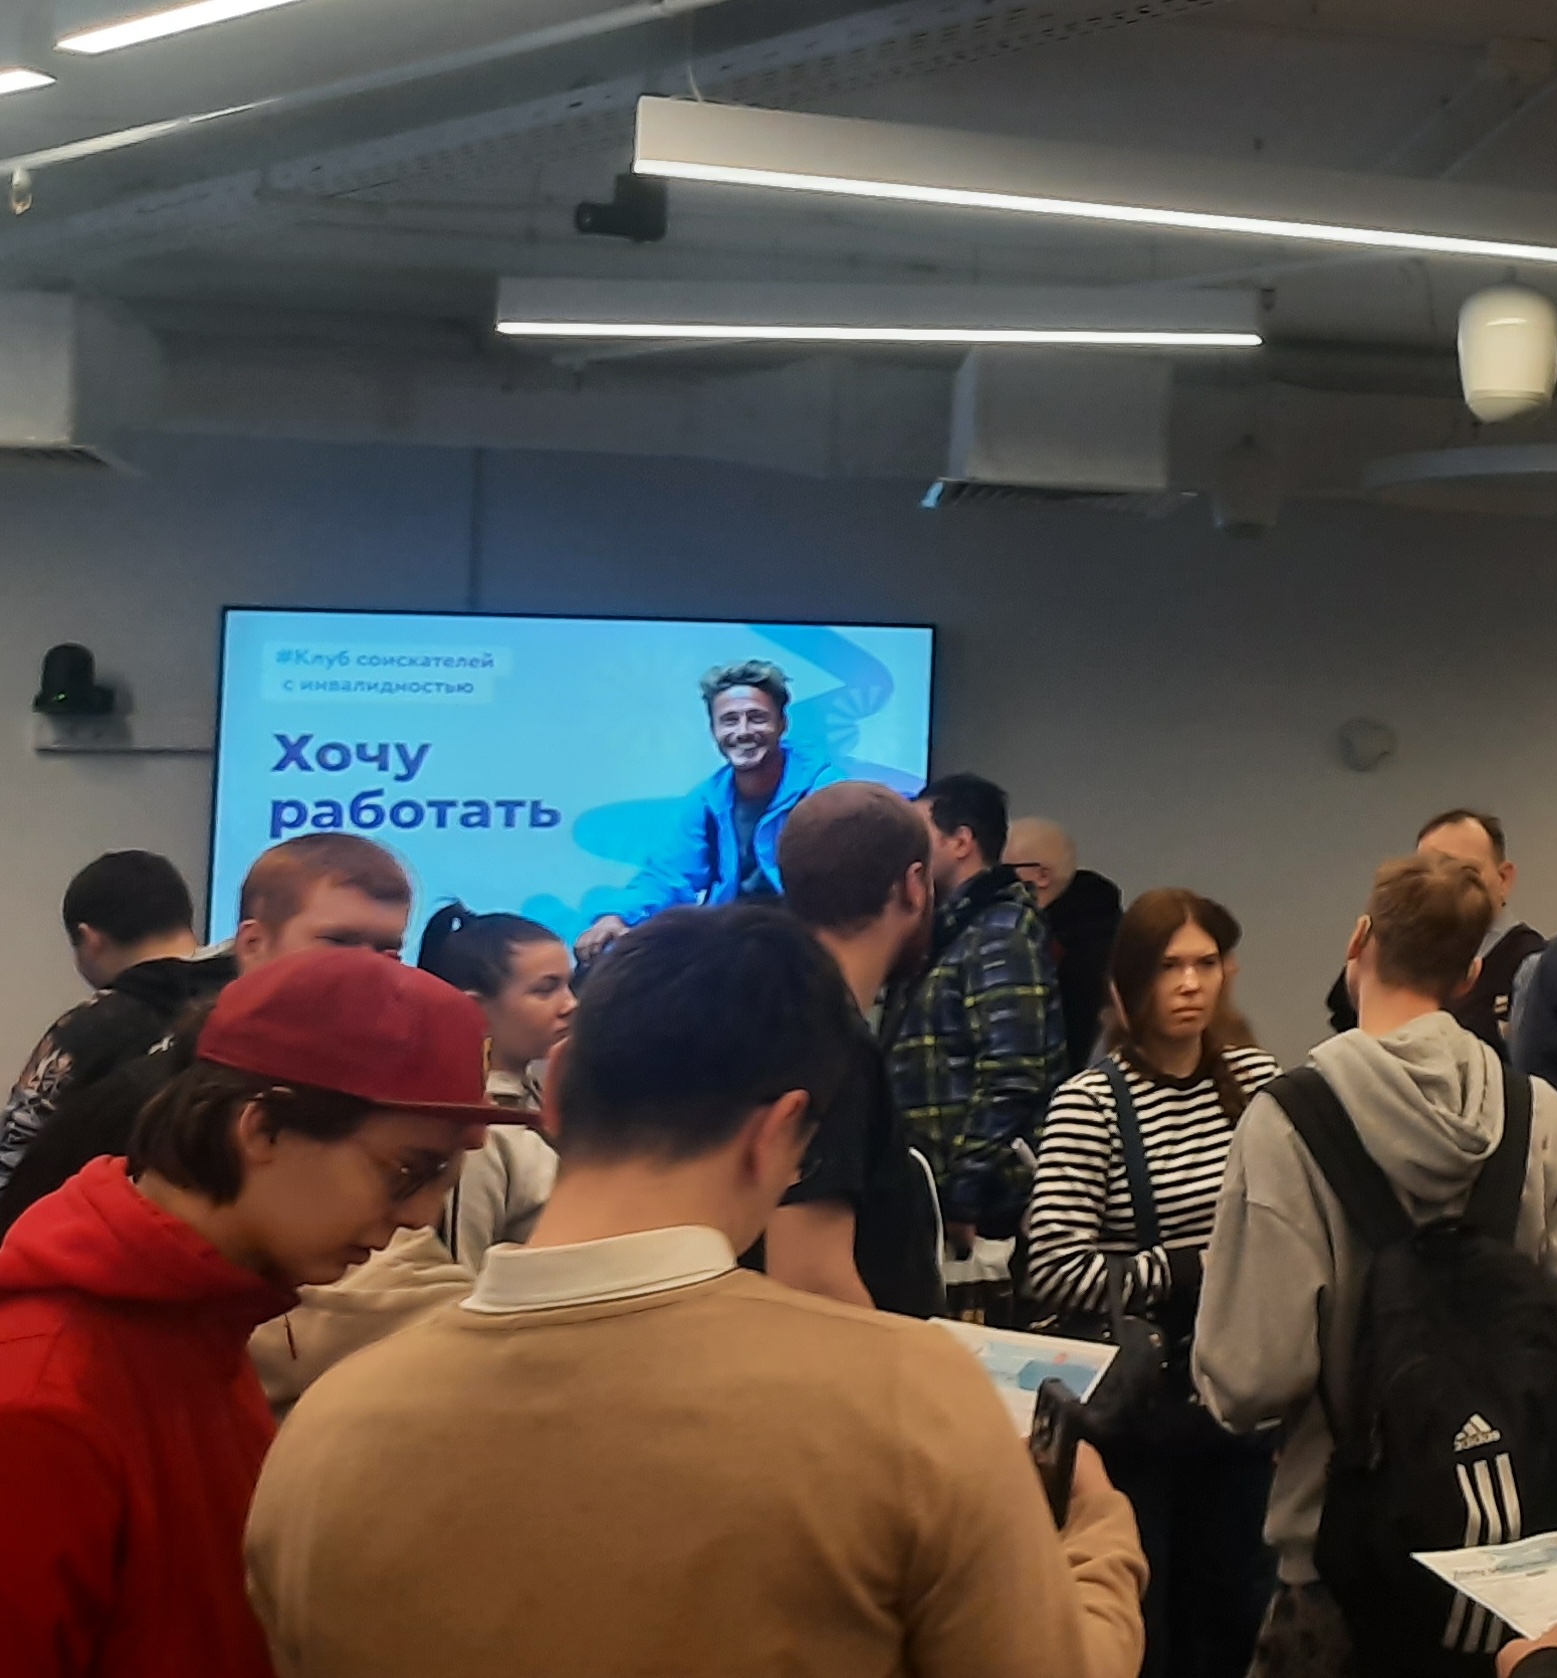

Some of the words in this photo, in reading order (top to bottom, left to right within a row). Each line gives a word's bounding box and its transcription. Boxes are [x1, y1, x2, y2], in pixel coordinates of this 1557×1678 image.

[356, 652, 495, 669] соискателей
[300, 679, 475, 695] инвалидностью
[271, 733, 432, 782] Хочу
[269, 788, 563, 839] работать
